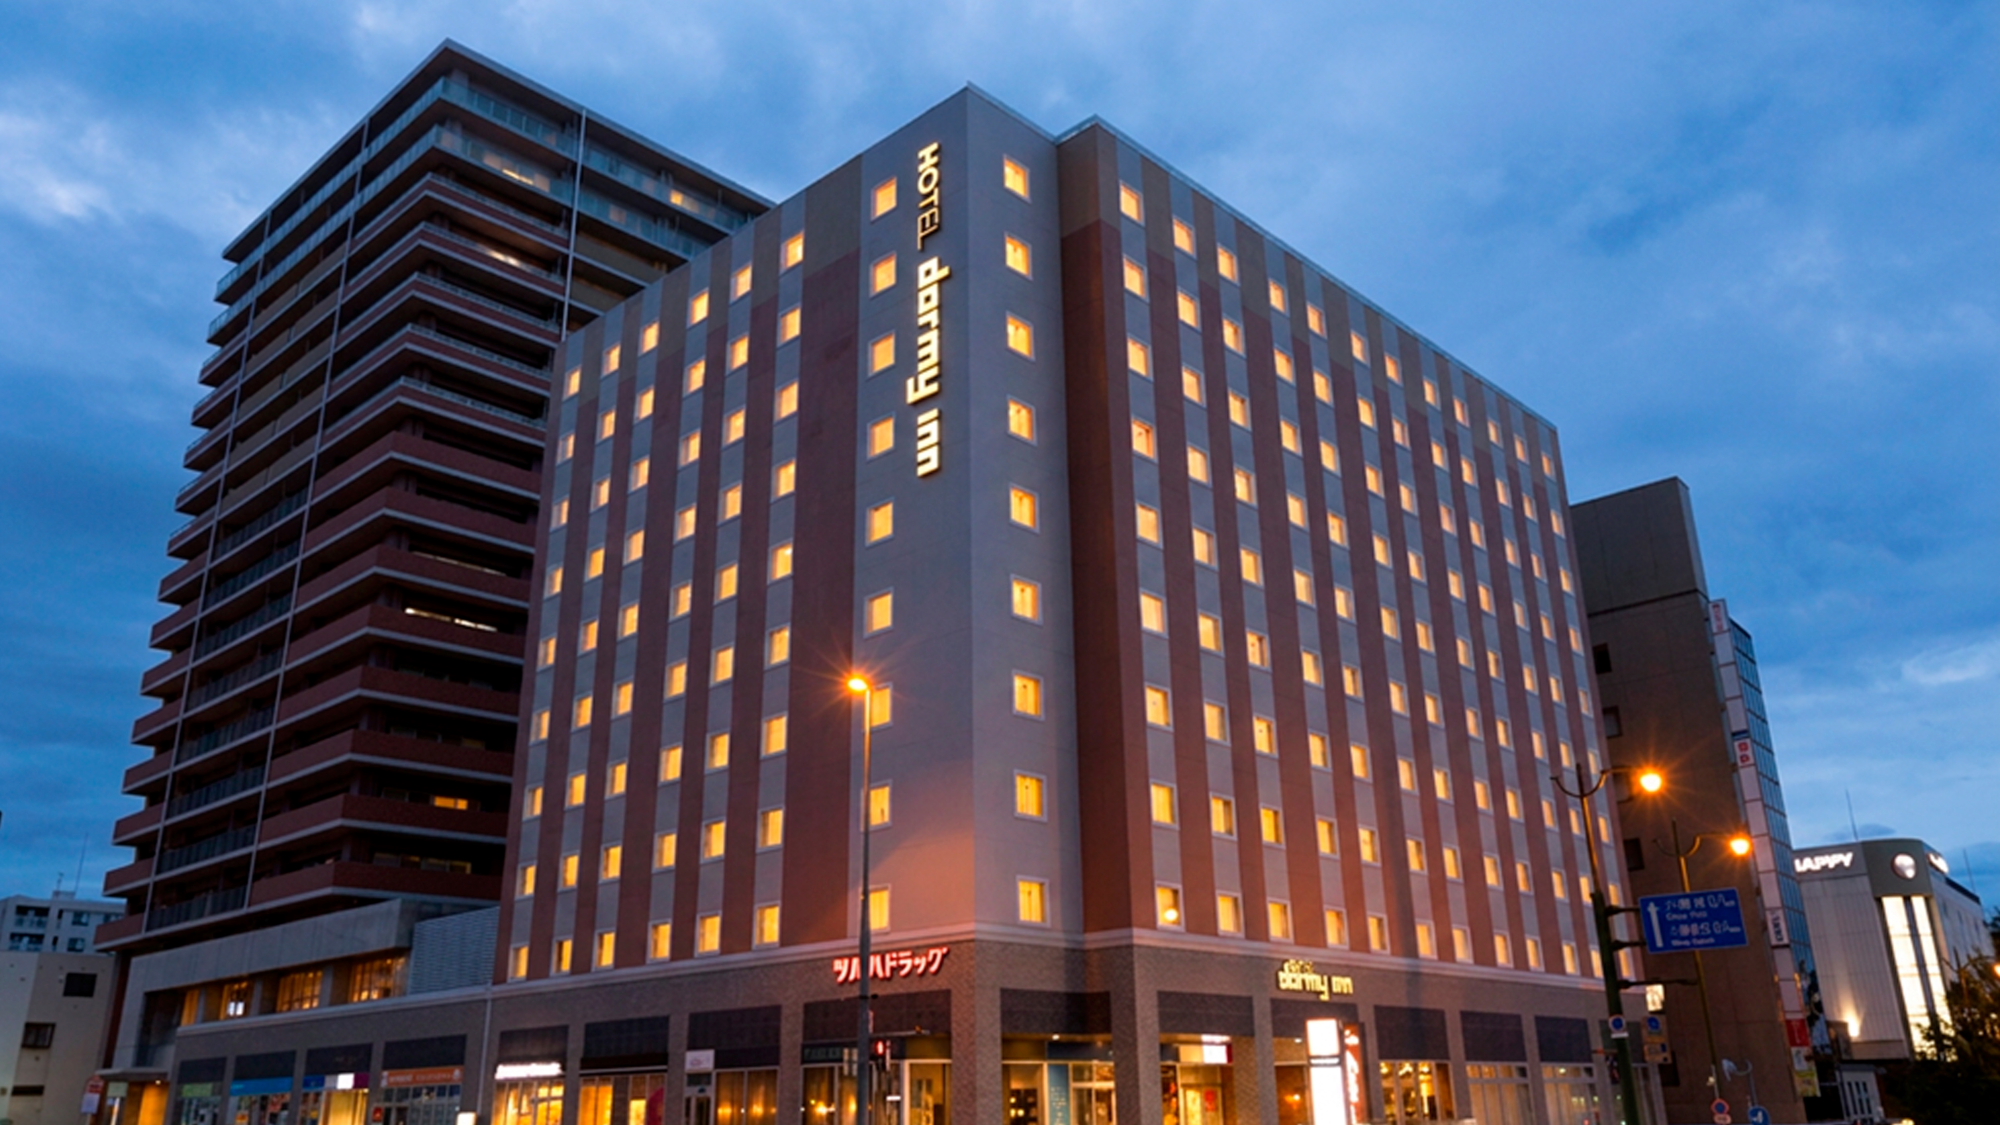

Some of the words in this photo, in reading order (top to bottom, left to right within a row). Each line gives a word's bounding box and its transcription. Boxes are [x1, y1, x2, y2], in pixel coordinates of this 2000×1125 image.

[917, 142, 941, 250] HOTEL
[906, 256, 950, 404] dormy
[916, 407, 941, 478] inn
[1277, 961, 1330, 1001] dormy
[1331, 975, 1354, 995] inn
